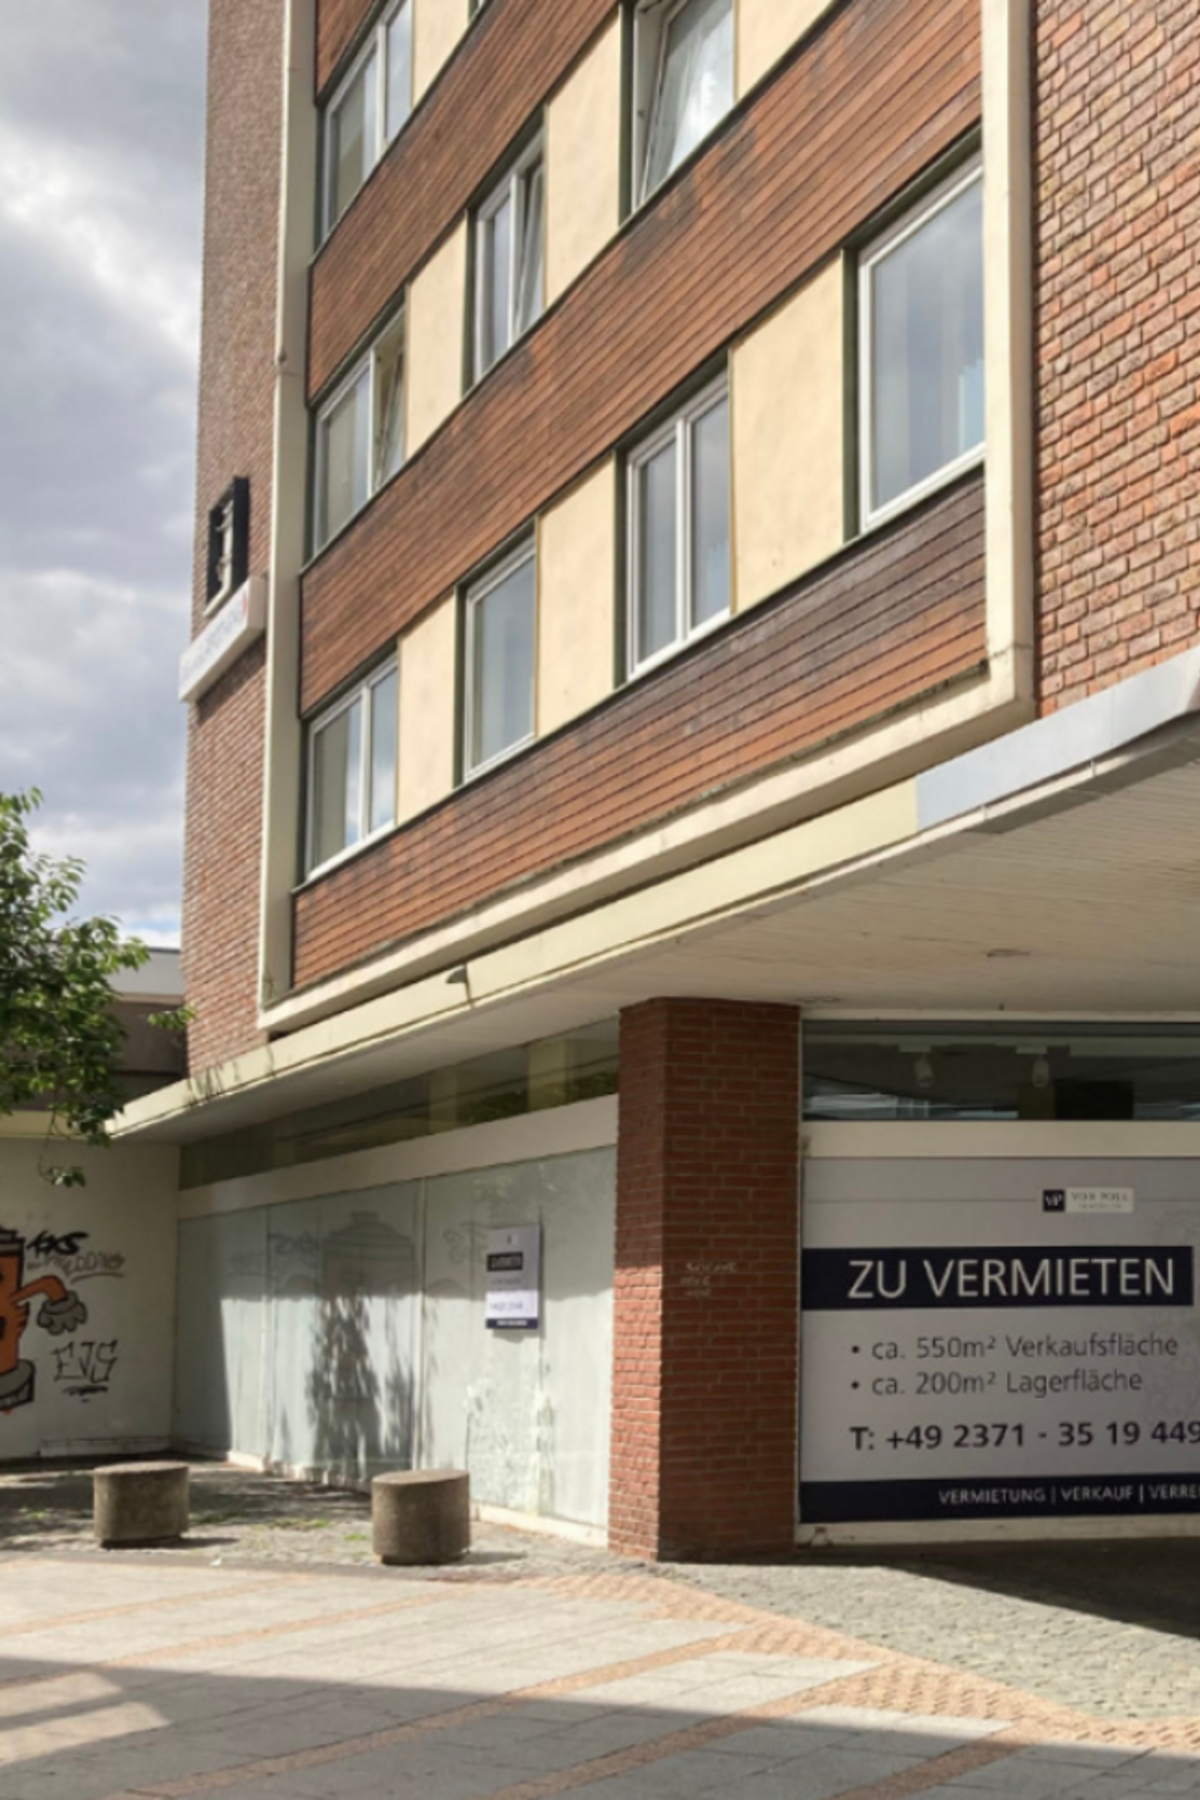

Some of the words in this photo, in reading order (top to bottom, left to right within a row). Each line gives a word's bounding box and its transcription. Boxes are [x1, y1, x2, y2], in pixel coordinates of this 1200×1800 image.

[847, 1260, 907, 1299] ZU
[923, 1258, 1174, 1298] VERMIETEN
[871, 1341, 906, 1360] ca.
[916, 1336, 997, 1359] 550m²
[1005, 1332, 1179, 1358] Verkaufsfläche
[871, 1377, 905, 1395] ca.
[915, 1371, 996, 1395] 200m²
[1006, 1367, 1144, 1399] Lagerfläche
[849, 1426, 875, 1451] T:
[886, 1424, 943, 1450] +49
[953, 1423, 1024, 1448] 2371
[1058, 1422, 1094, 1447] 35
[1106, 1421, 1141, 1446] 19
[938, 1488, 1046, 1505] VERMIETUNG
[1060, 1485, 1134, 1502] VERKAUF
